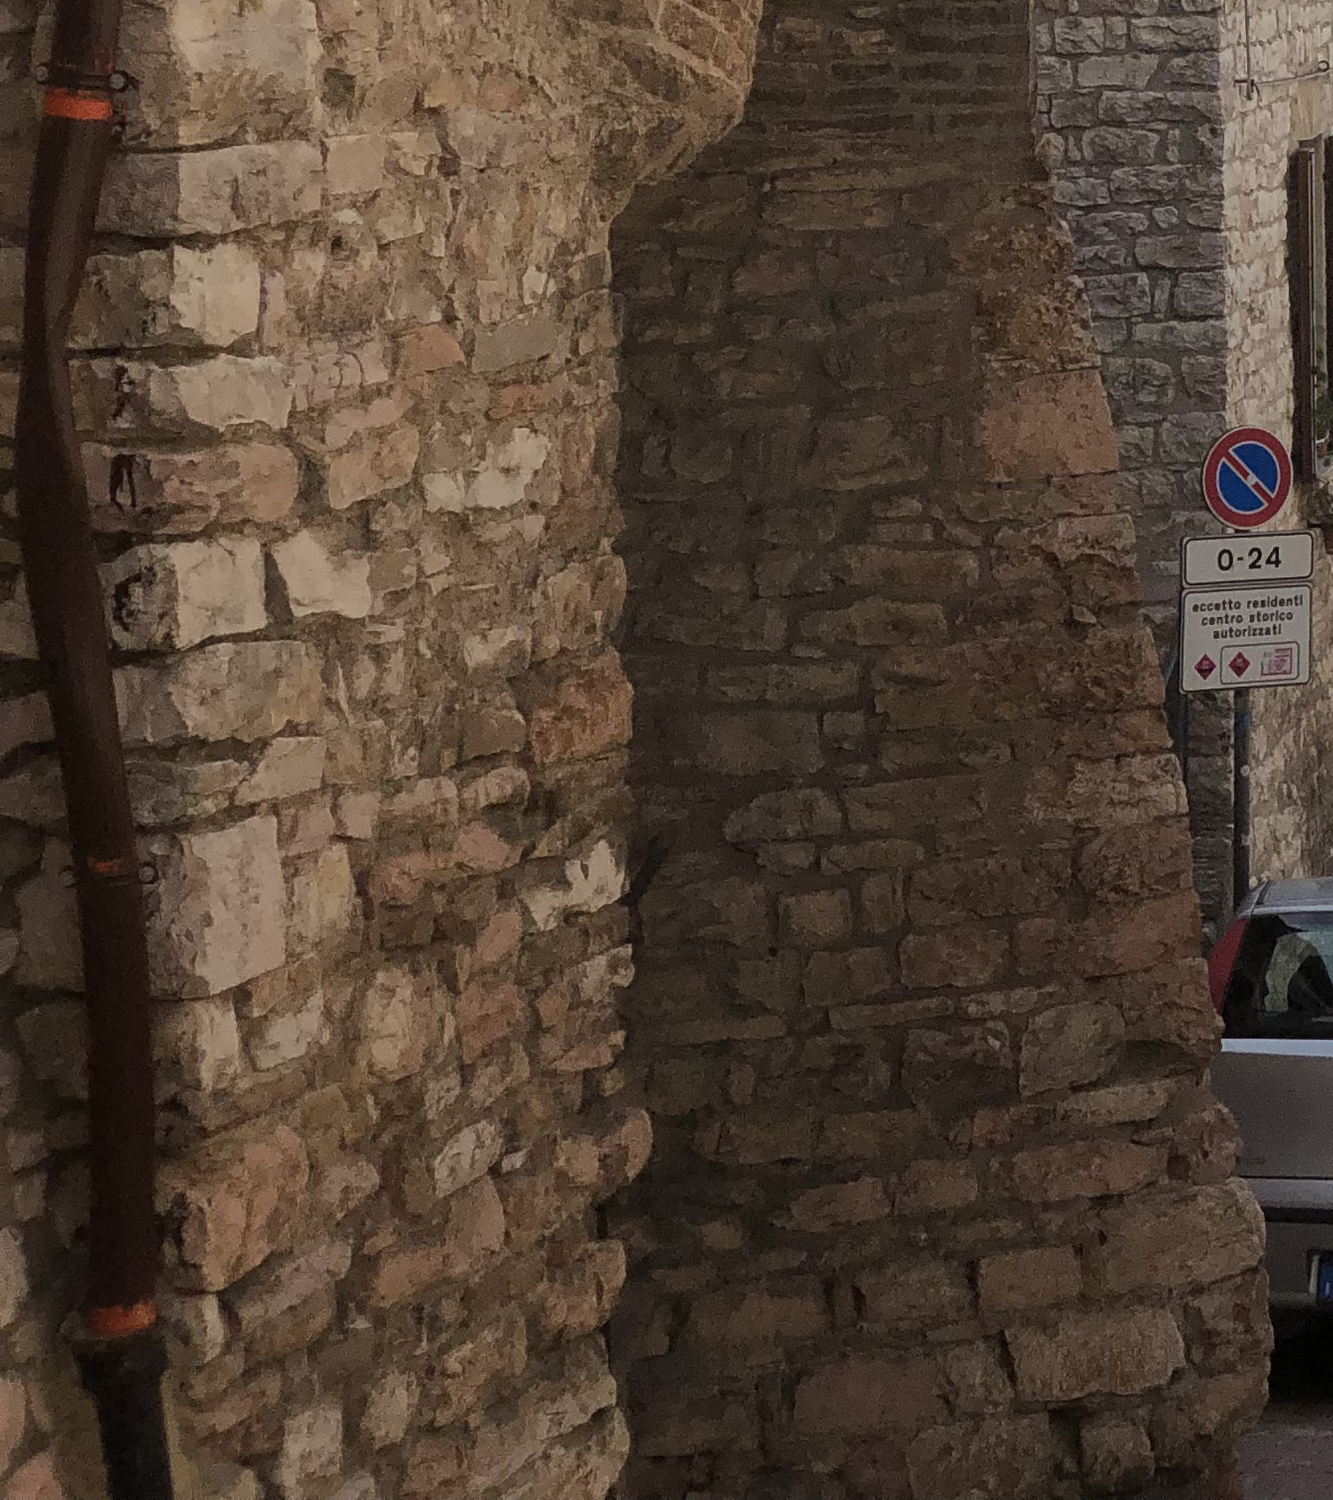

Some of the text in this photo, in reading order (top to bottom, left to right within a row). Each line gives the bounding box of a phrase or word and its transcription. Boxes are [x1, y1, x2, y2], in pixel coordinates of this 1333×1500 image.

[1217, 546, 1281, 571] 0-24
[1191, 595, 1303, 612] eccetto residenti
[1201, 610, 1293, 626] centro storico
[1213, 624, 1281, 639] autorizzati
